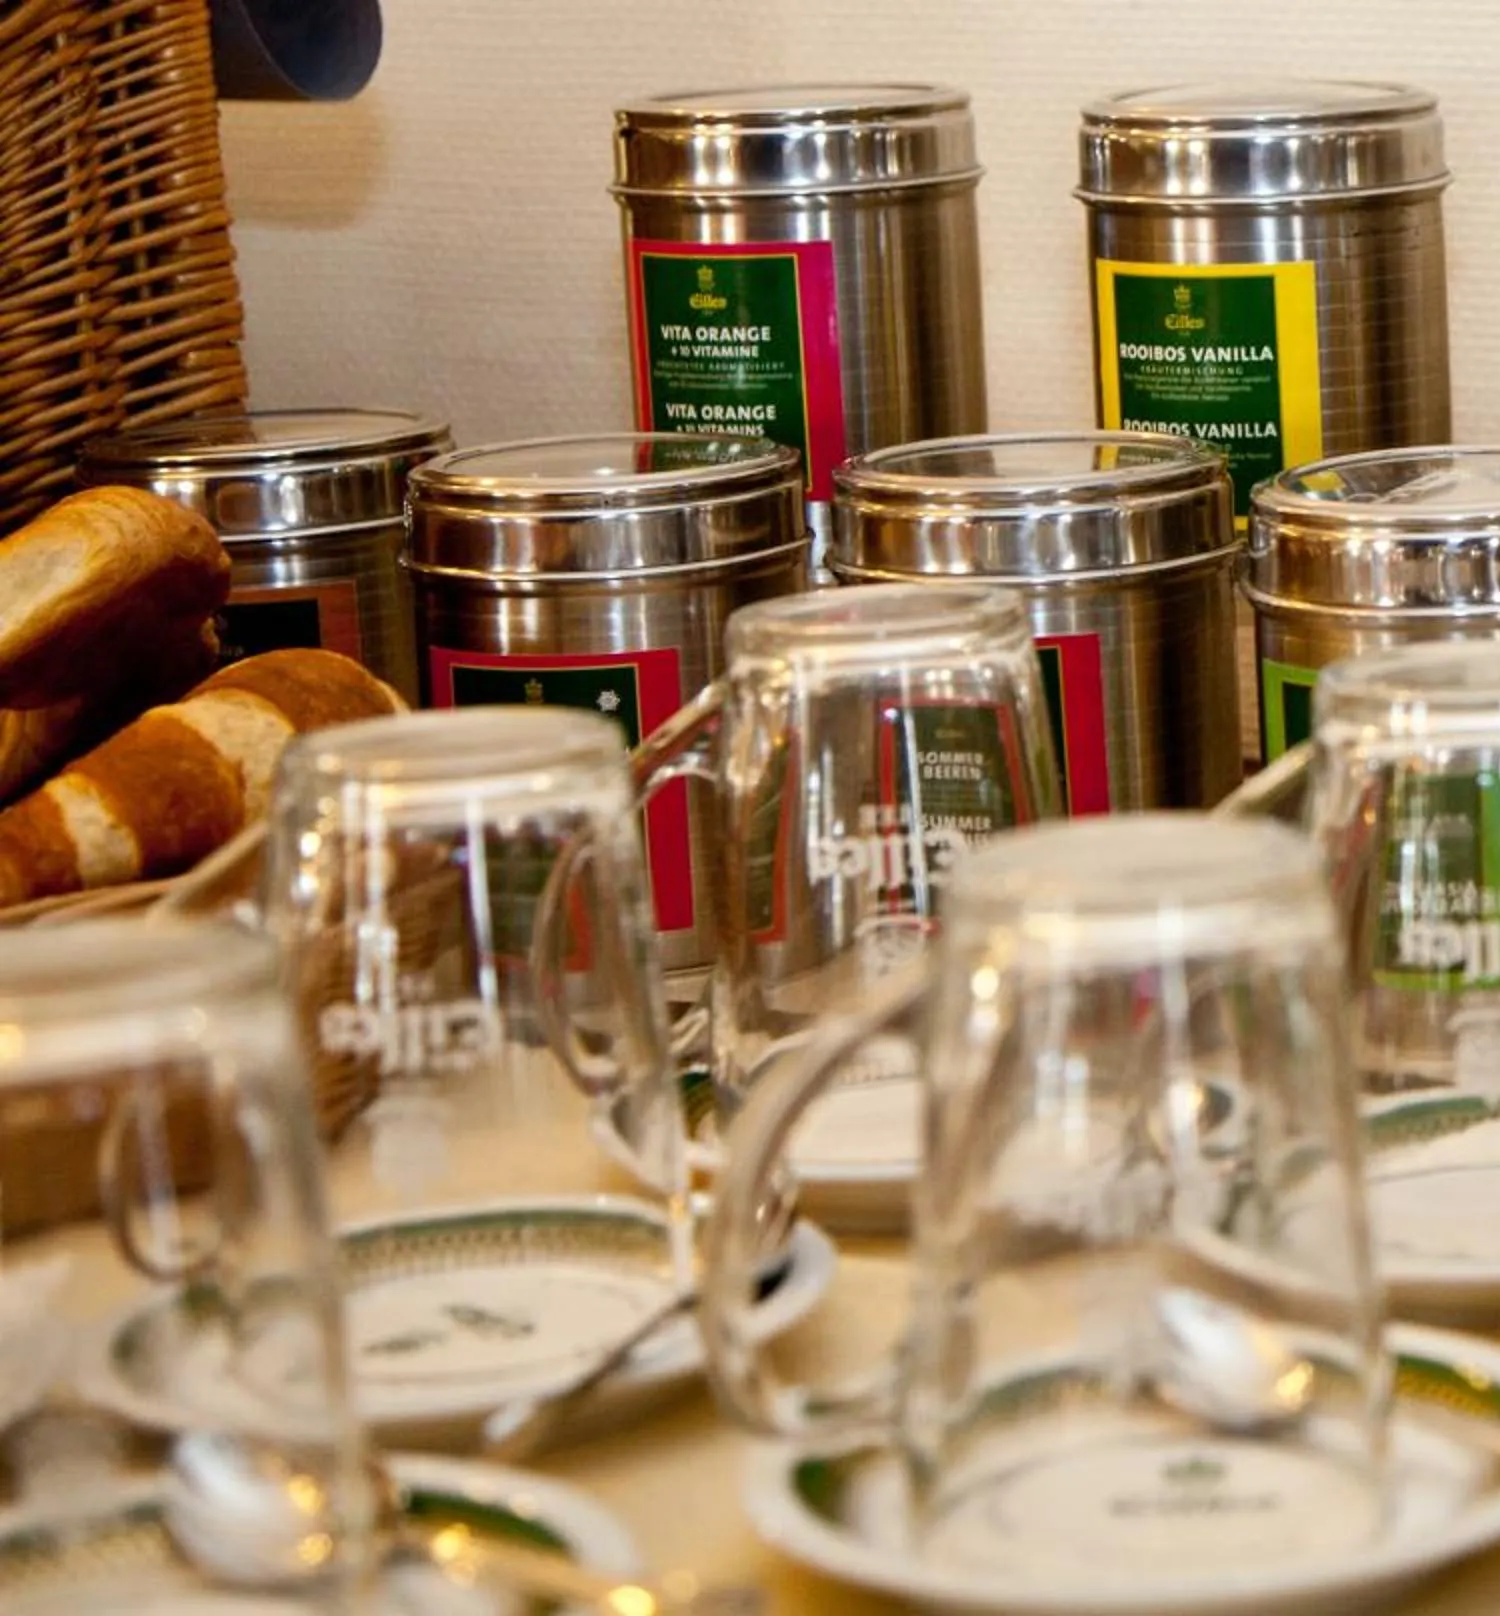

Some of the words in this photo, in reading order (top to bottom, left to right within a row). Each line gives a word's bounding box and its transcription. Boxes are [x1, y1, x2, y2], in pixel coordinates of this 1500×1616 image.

[661, 325, 692, 341] VITA
[695, 326, 772, 342] ORANGE
[691, 346, 760, 357] VITAMINE
[1120, 343, 1186, 362] ROOIBOS
[1191, 346, 1274, 362] VANILLA
[665, 402, 697, 419] VITA
[701, 404, 777, 420] ORANGE
[1195, 422, 1277, 439] VANILLA
